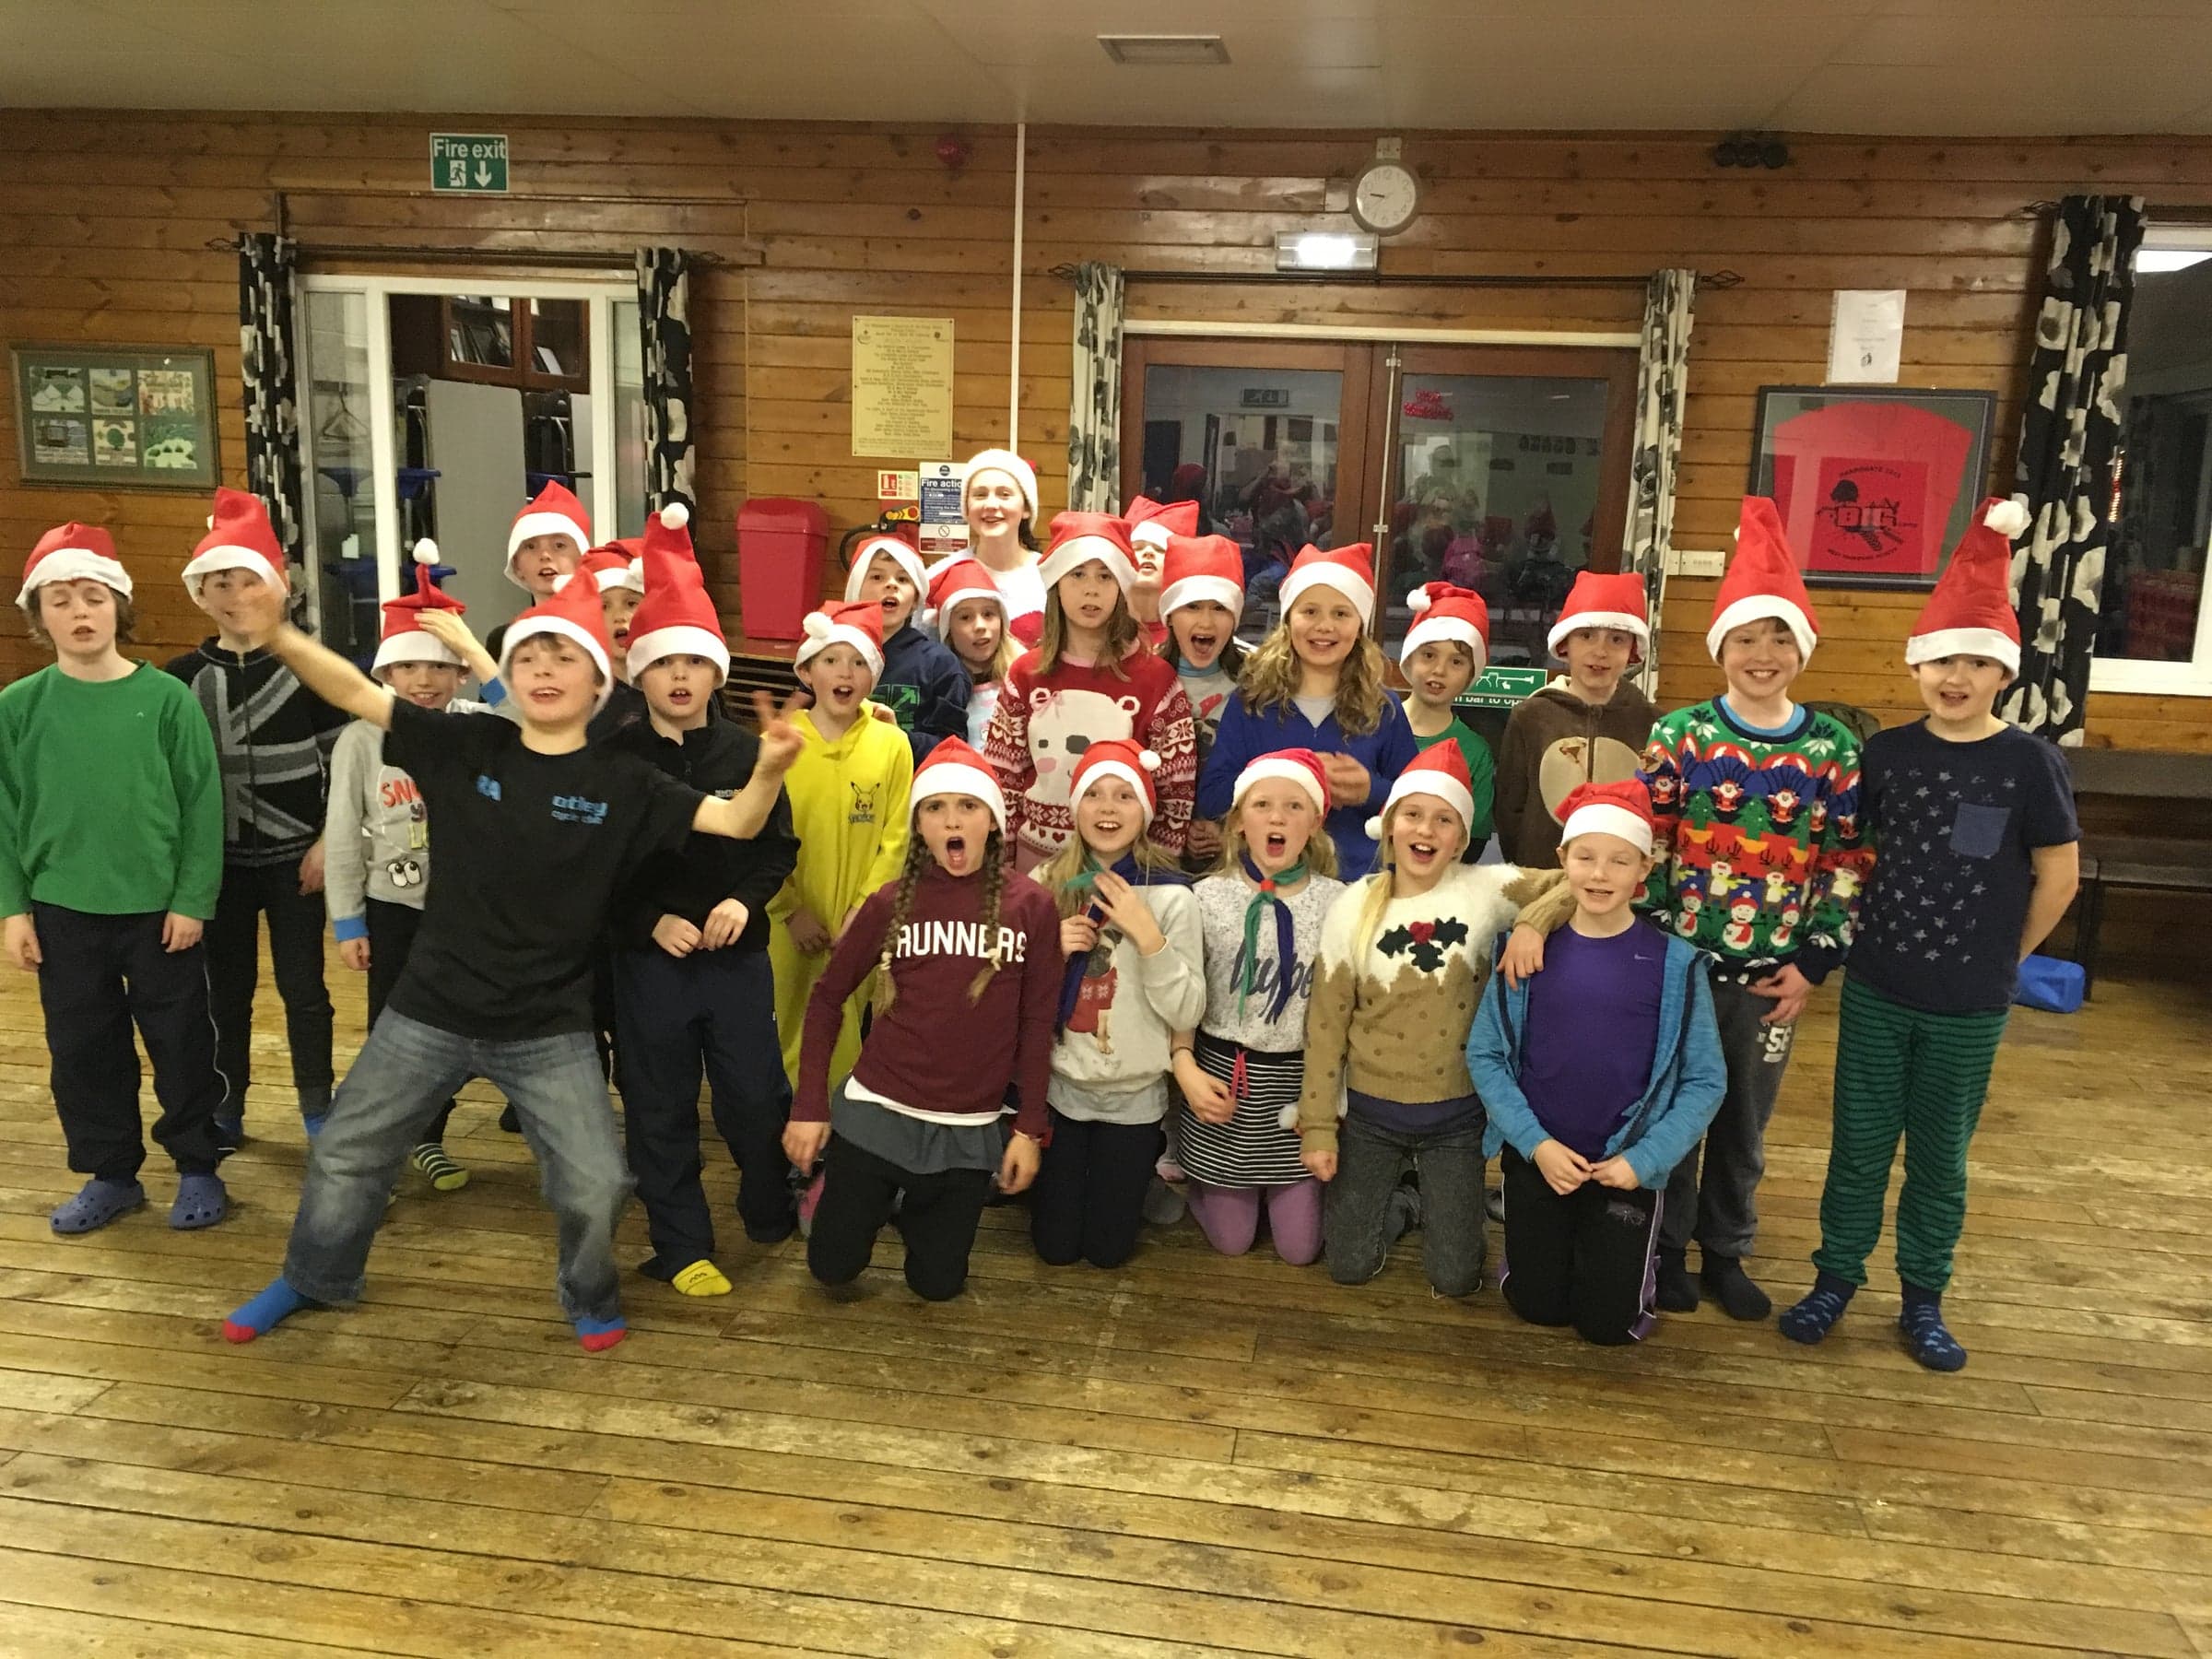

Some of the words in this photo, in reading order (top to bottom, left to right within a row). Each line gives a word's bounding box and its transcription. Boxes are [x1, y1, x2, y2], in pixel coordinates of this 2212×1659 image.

[433, 137, 468, 158] Fire
[472, 140, 506, 159] exit
[922, 478, 938, 488] Fire
[940, 479, 962, 488] actio
[896, 921, 1028, 963] RUNNERS
